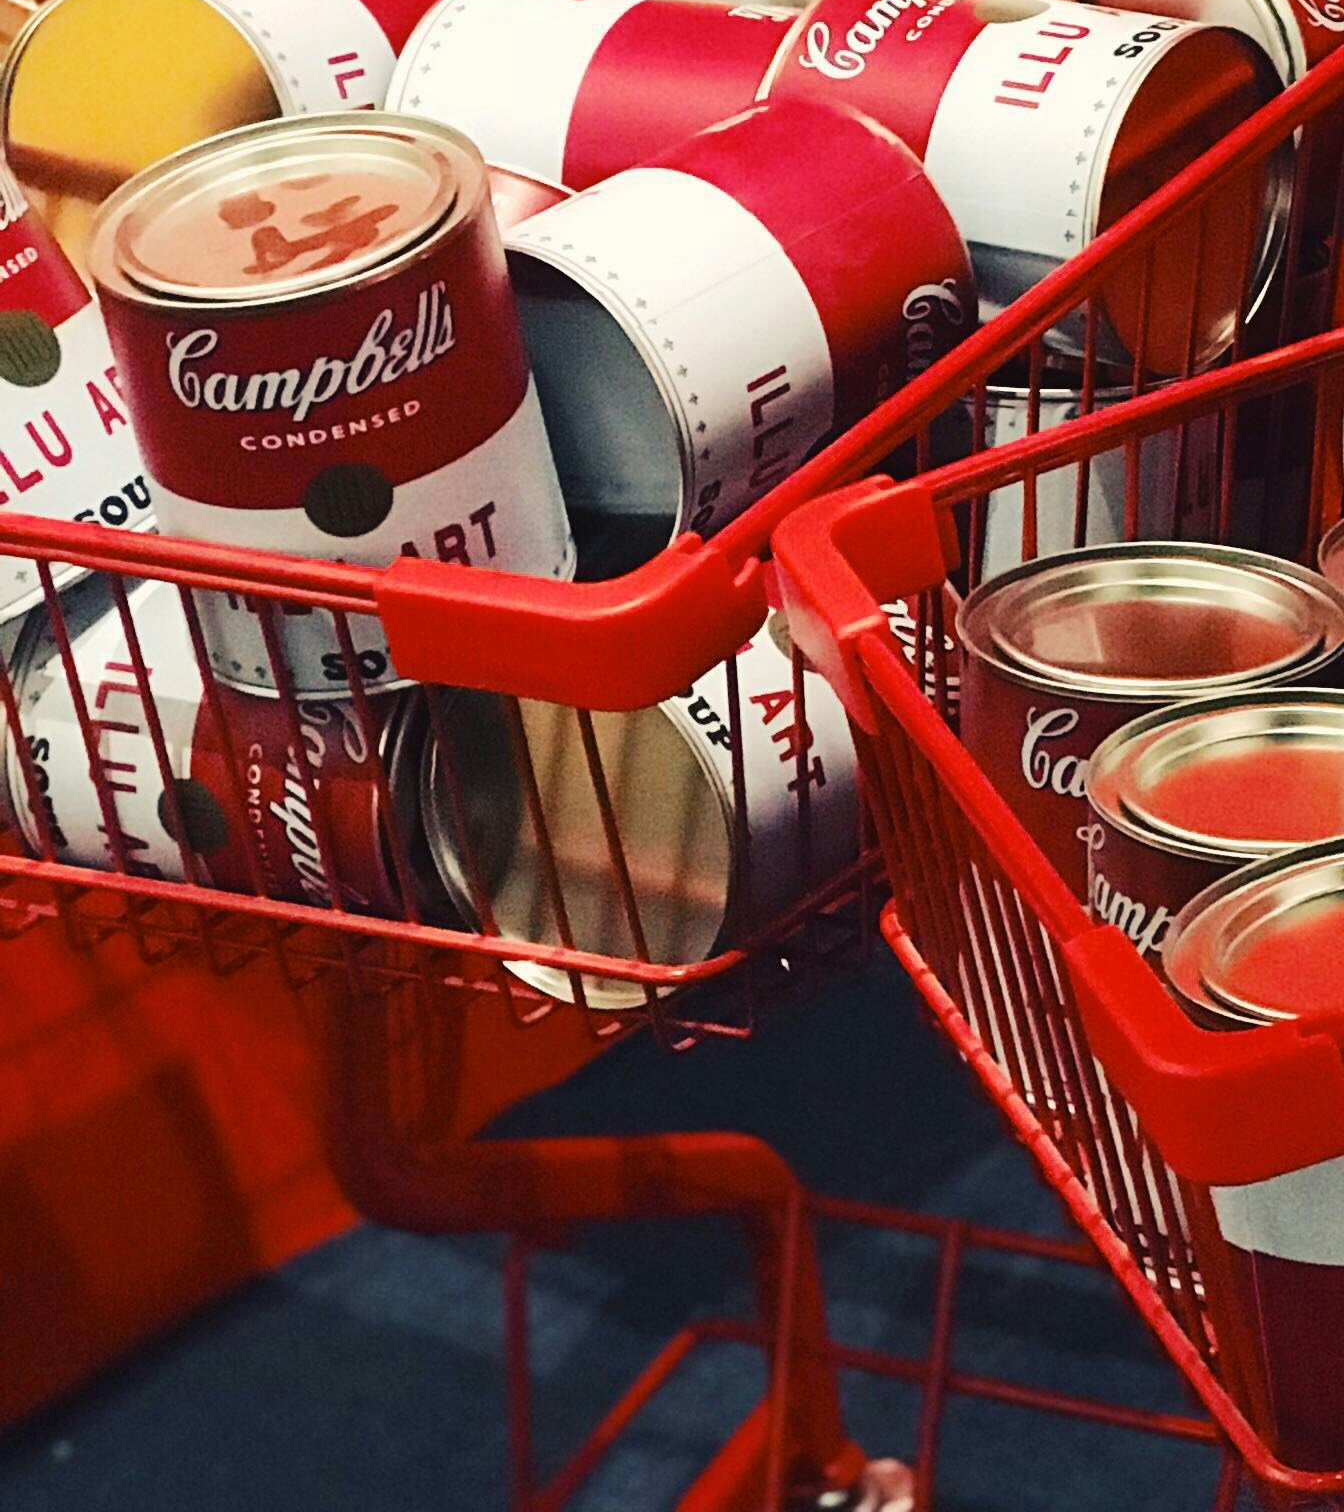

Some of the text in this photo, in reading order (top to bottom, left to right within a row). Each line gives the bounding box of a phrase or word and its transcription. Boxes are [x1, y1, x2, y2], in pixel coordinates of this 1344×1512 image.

[994, 21, 1092, 109] ILLU
[1113, 18, 1198, 59] SOU
[239, 400, 422, 451] CONDENSED
[749, 689, 827, 793] ART
